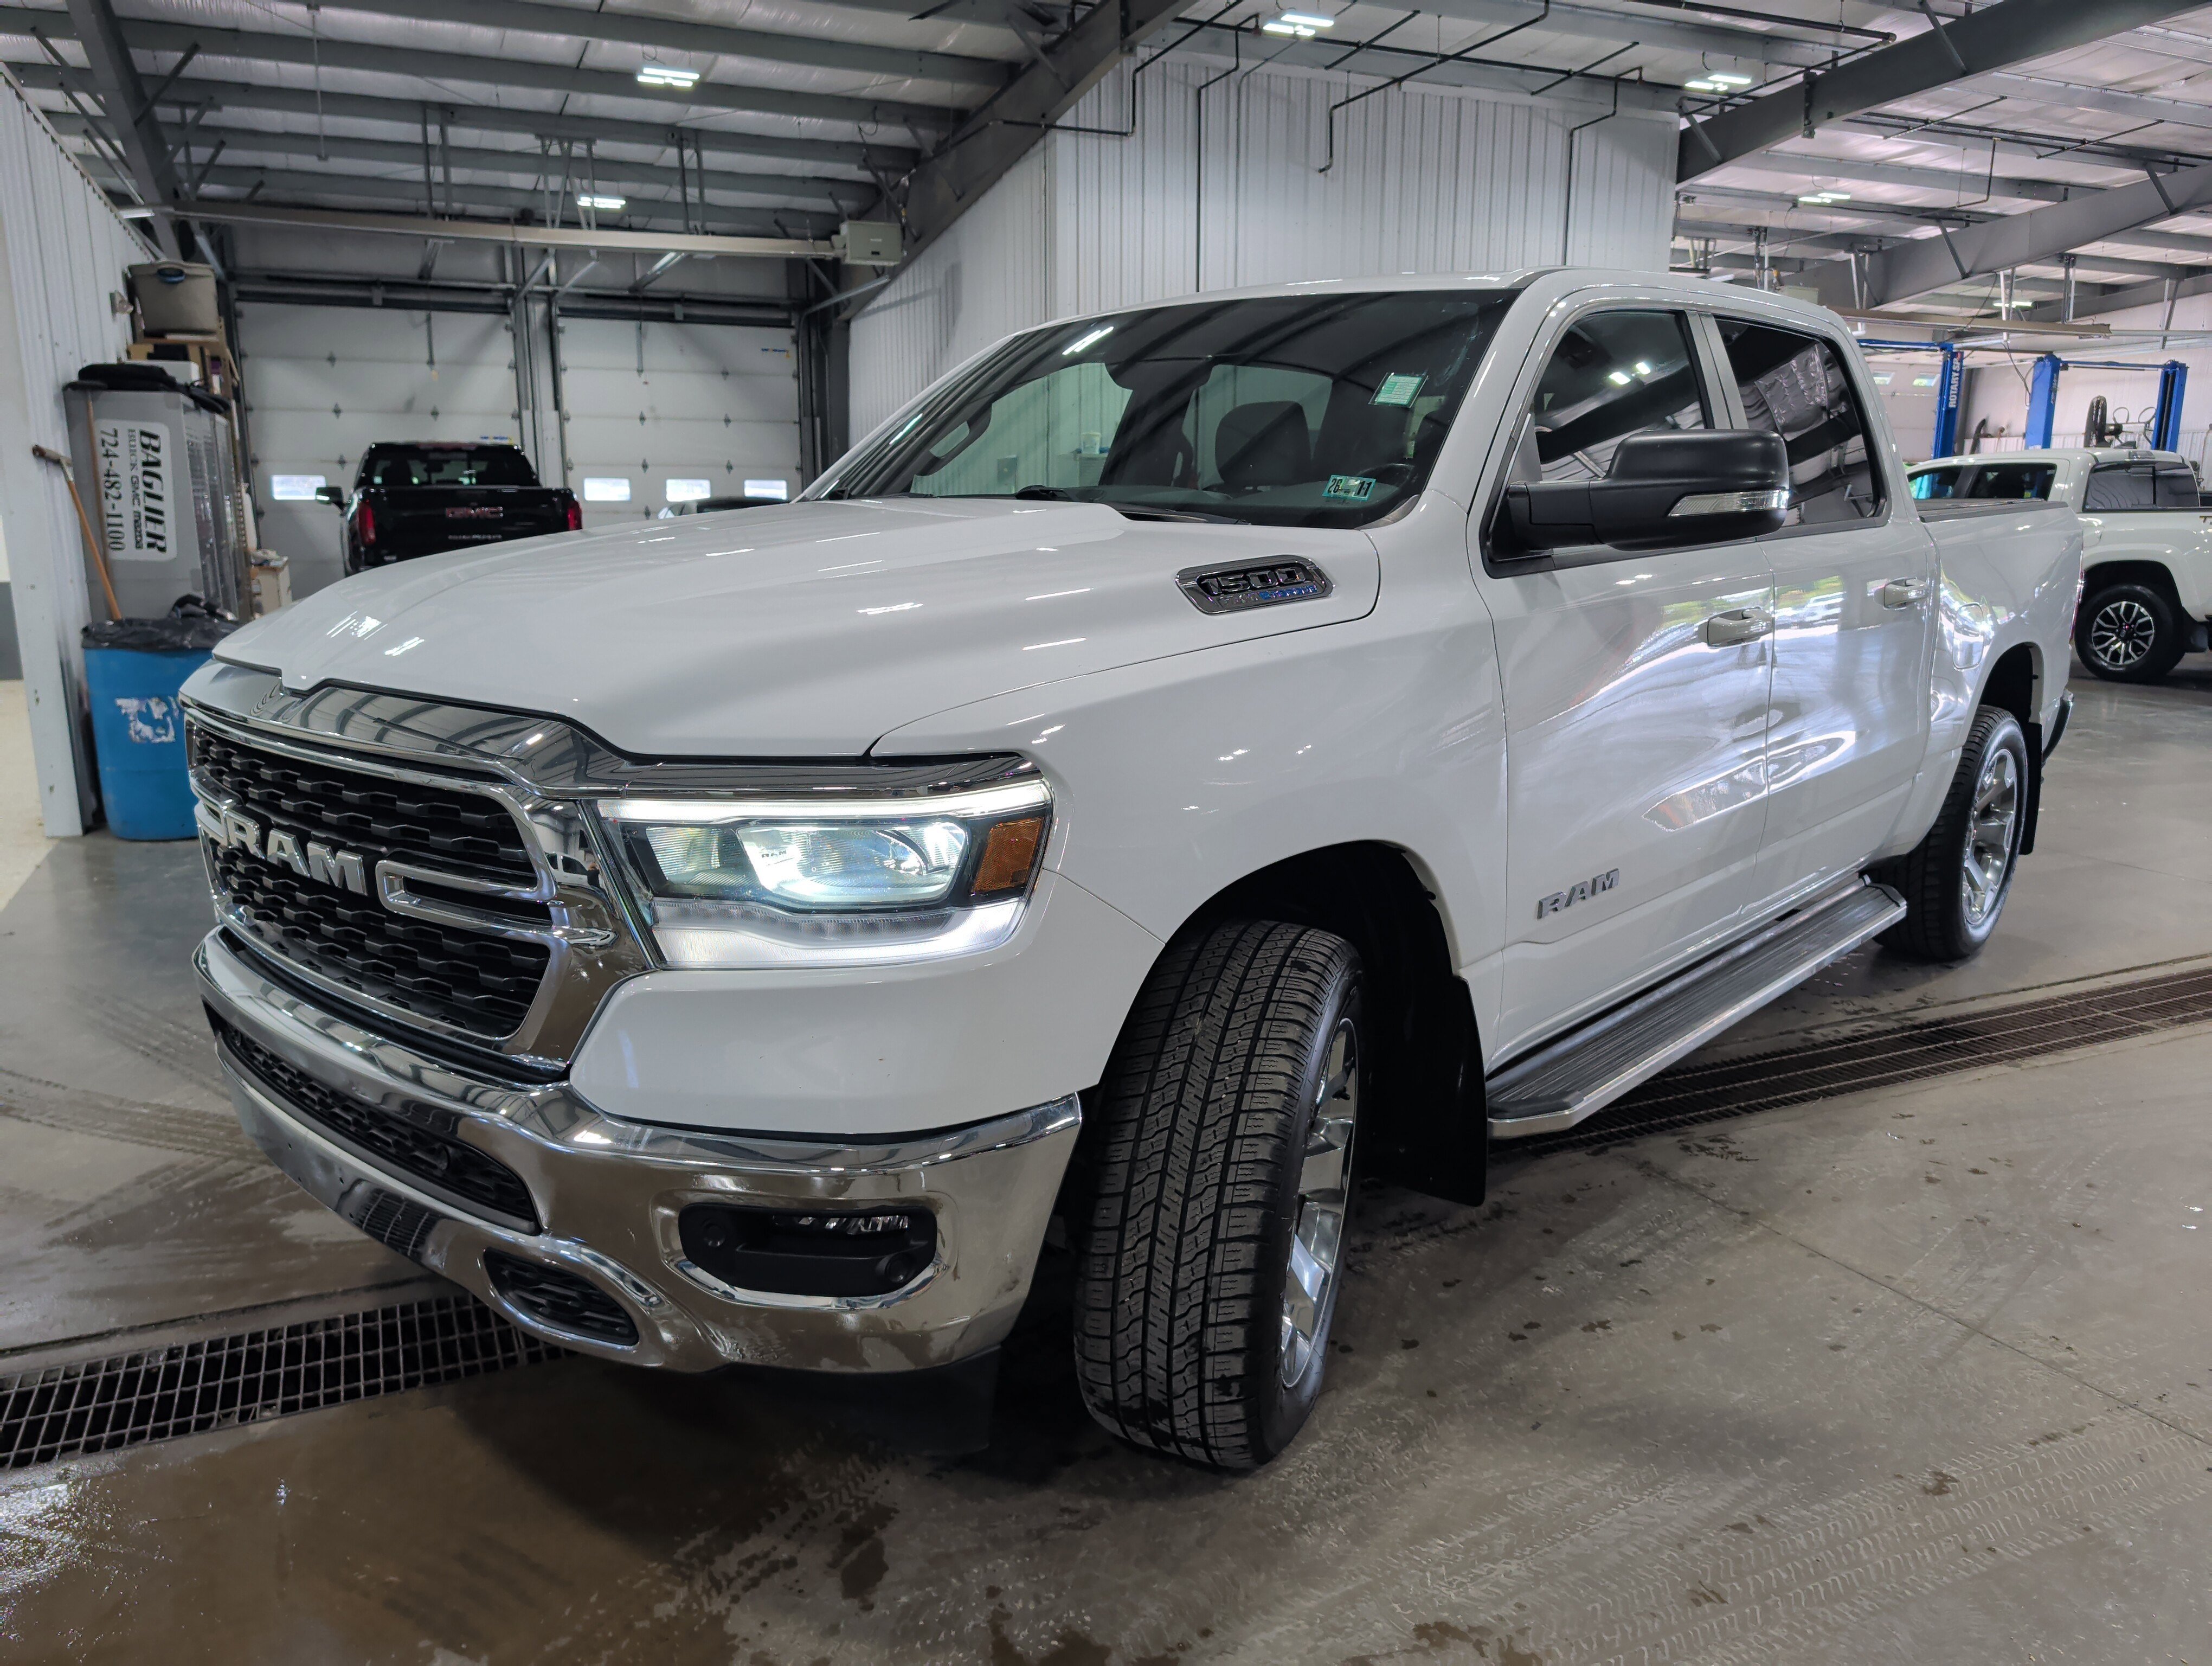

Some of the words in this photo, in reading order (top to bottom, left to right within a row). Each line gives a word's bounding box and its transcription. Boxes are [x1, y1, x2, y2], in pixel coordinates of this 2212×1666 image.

[1949, 371, 1959, 408] ROTARY
[100, 427, 126, 552] 724-482-1100
[131, 475, 140, 507] GMC
[139, 428, 167, 553] BAGLIER
[1327, 478, 1343, 494] 26
[1199, 568, 1306, 596] 1500
[225, 810, 368, 896] RAM
[1536, 868, 1620, 920] RAM
